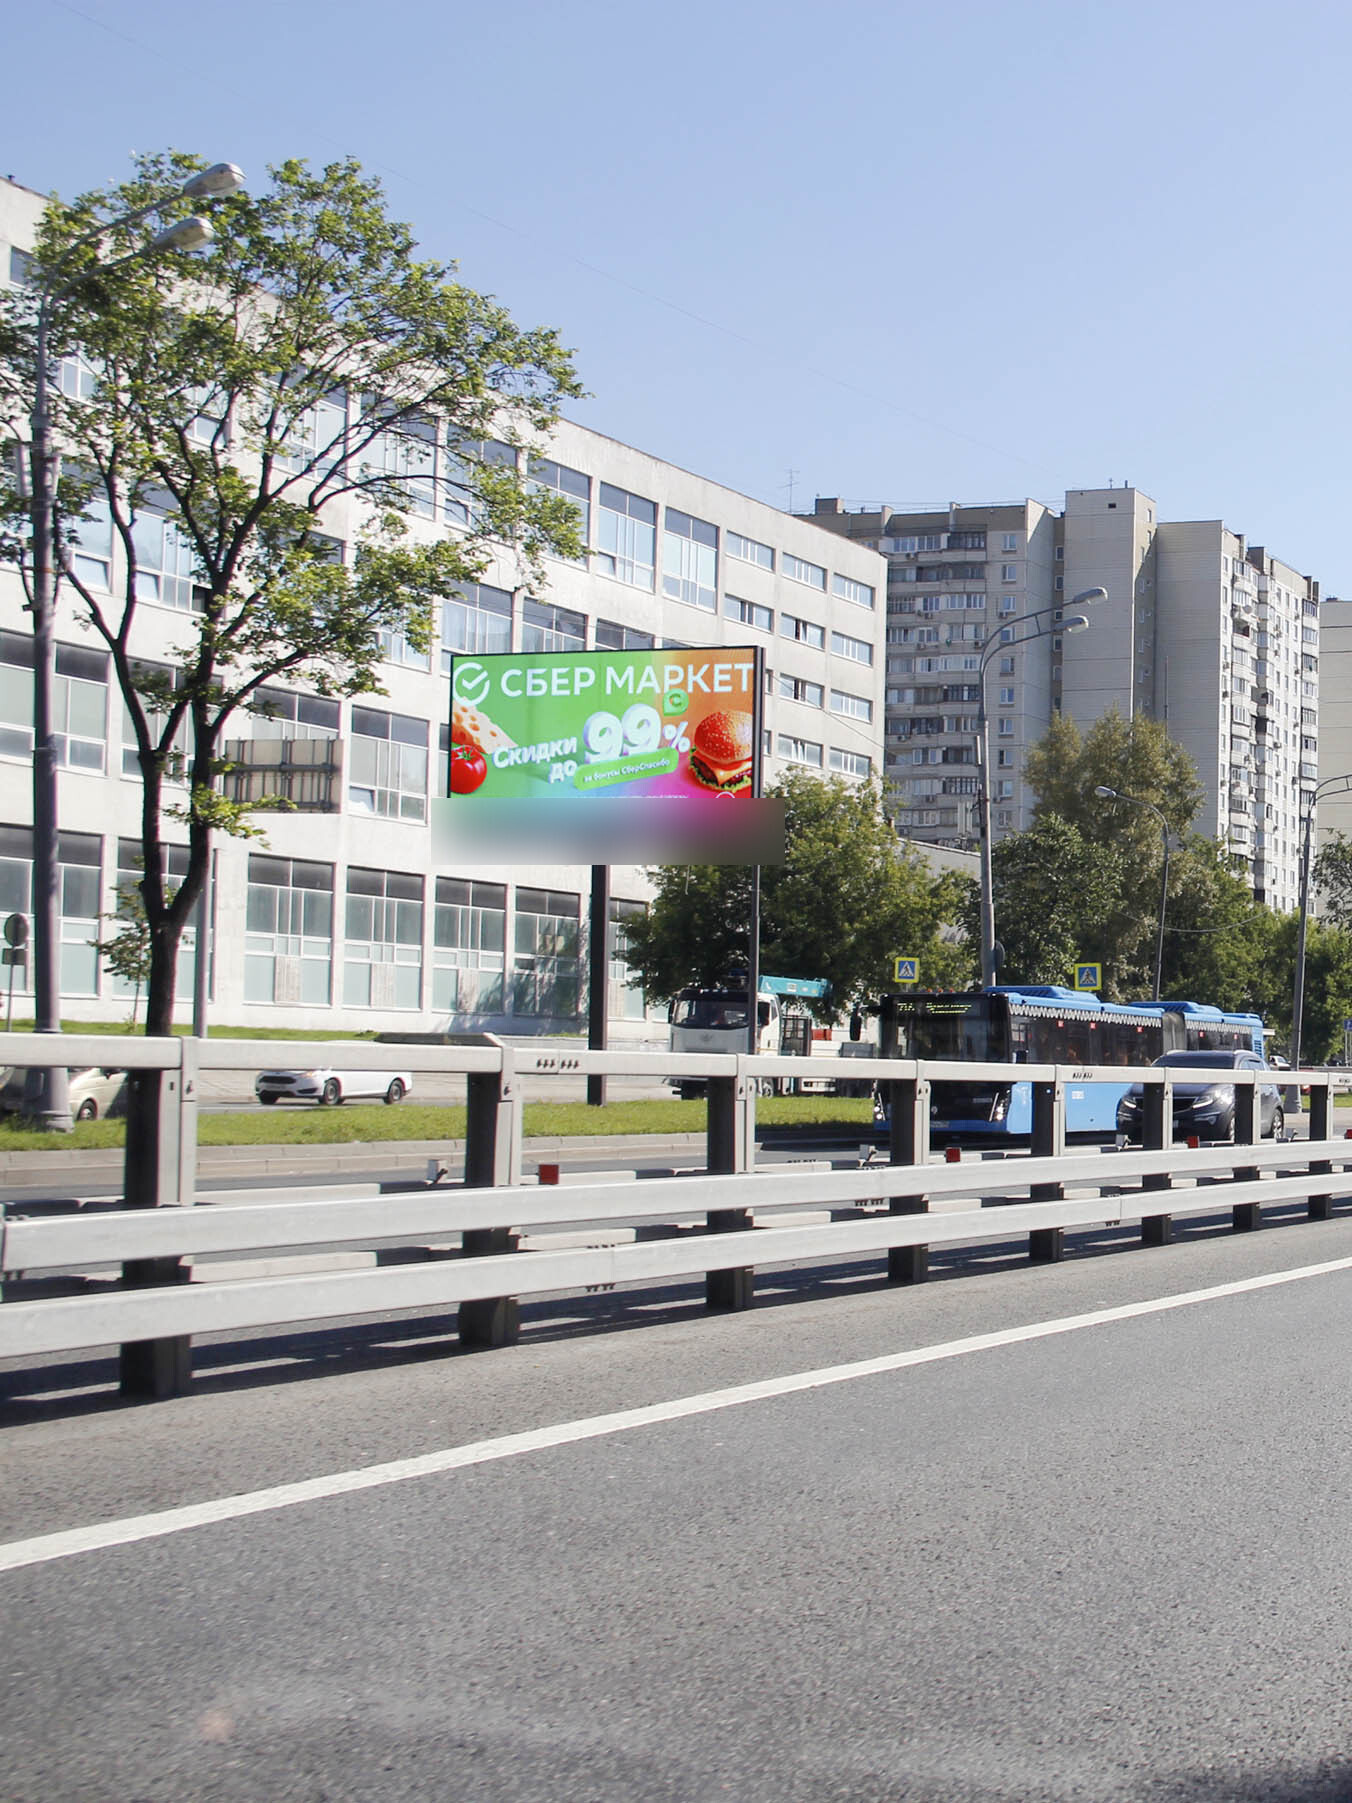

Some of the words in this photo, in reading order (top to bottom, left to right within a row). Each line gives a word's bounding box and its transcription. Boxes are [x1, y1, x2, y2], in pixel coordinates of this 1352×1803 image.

[500, 667, 596, 697] СБЕР
[605, 663, 755, 695] МАРКЕТ
[492, 737, 578, 768] Скидки
[549, 758, 576, 784] до
